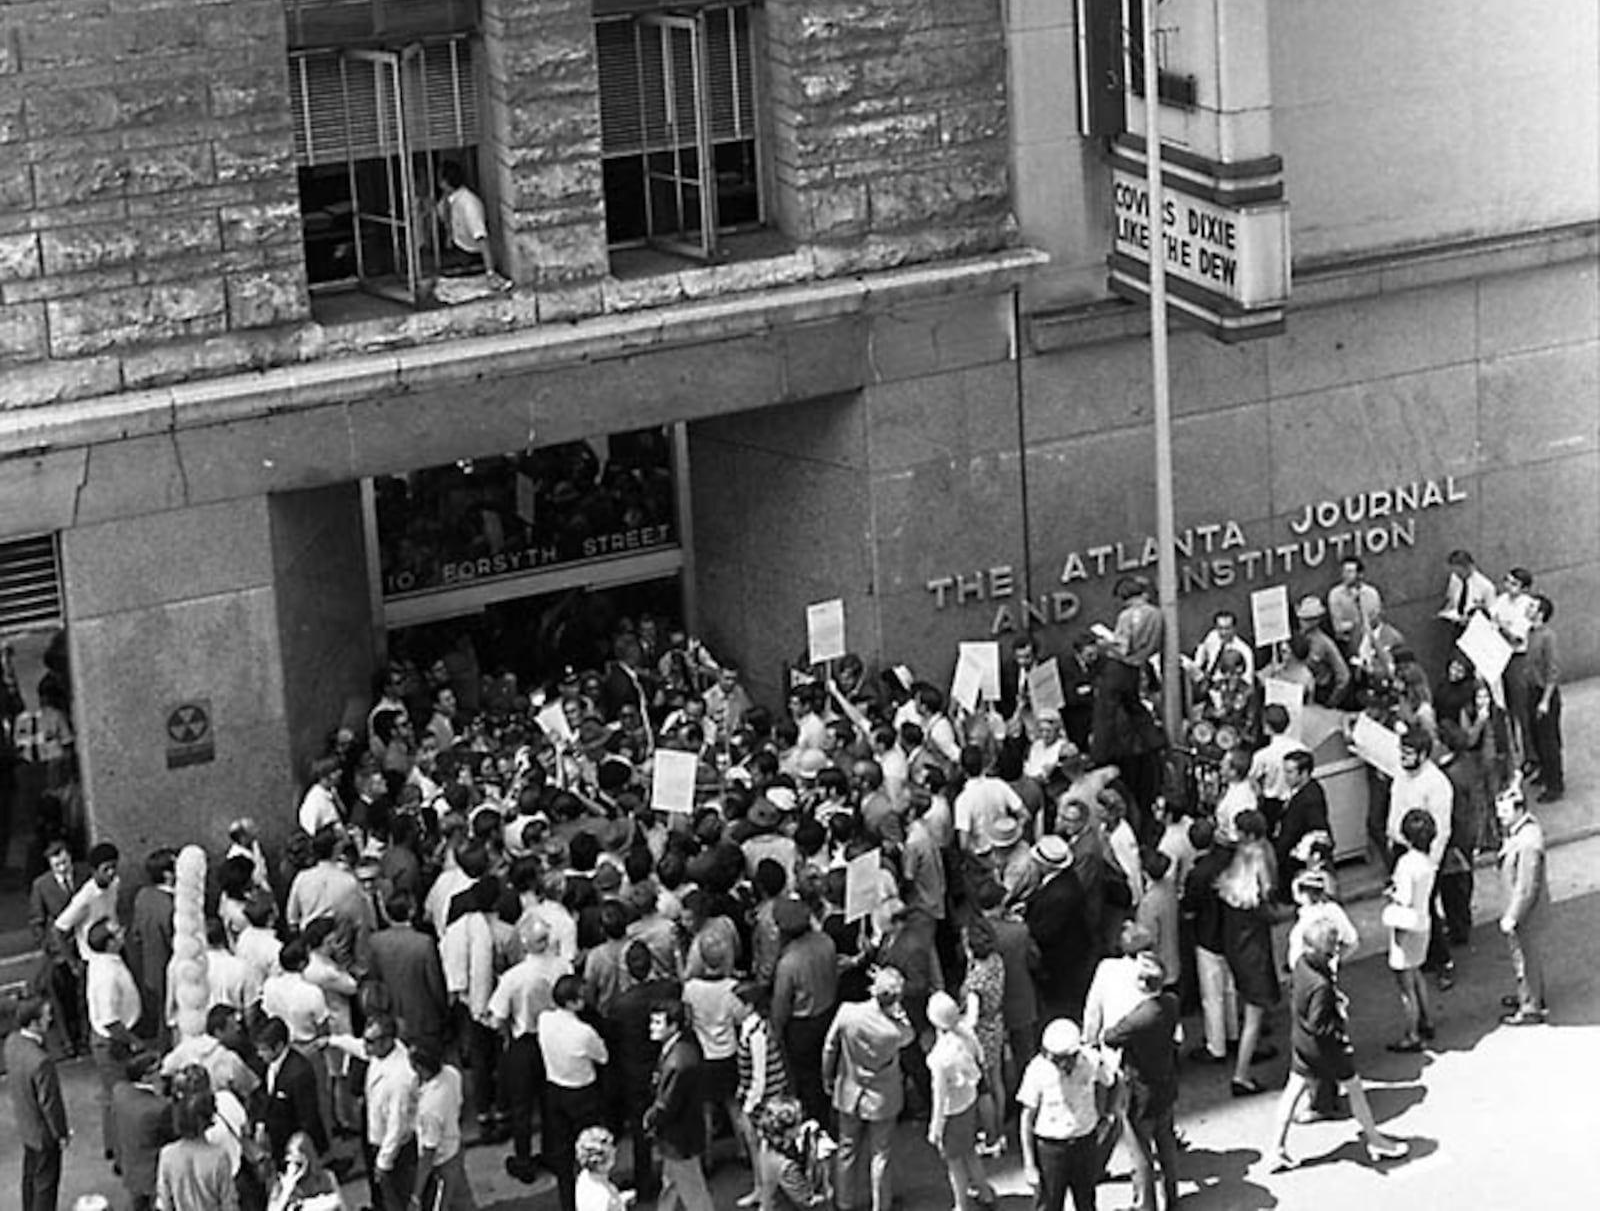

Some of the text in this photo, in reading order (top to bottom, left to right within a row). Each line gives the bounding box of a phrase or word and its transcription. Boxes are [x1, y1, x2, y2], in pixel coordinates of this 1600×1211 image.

[1116, 181, 1236, 250] COVS DIXIE
[1118, 217, 1237, 287] LIKE HE DEW
[581, 523, 671, 557] STREET
[926, 475, 1468, 609] THE ATLANTA JOURNAL
[991, 518, 1416, 634] AND NSTITUTION
